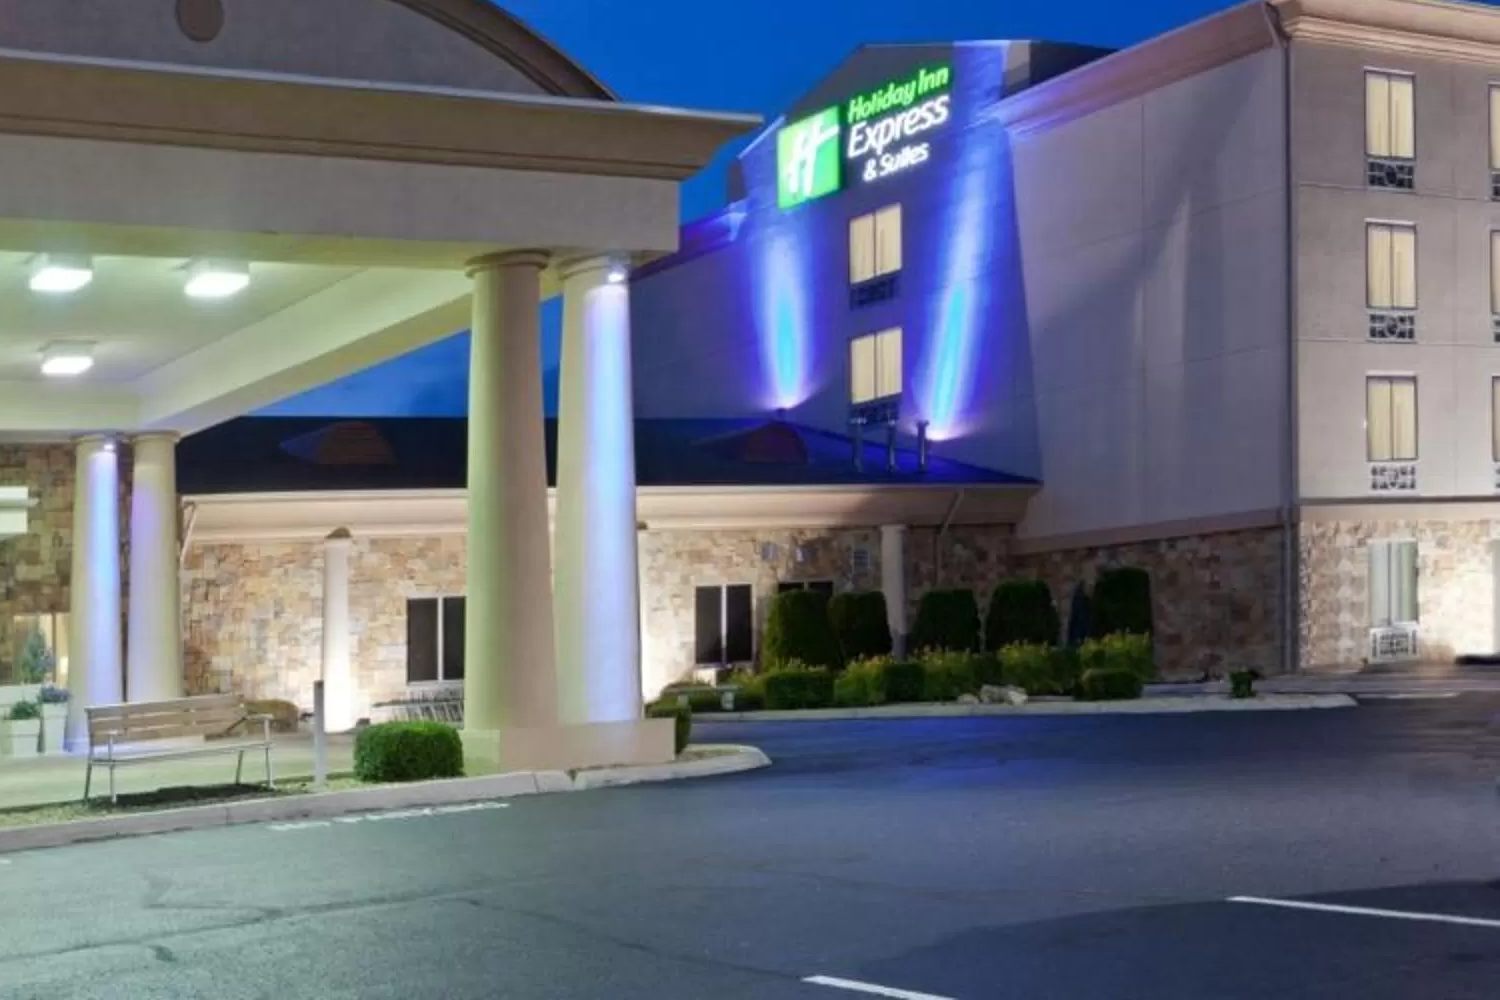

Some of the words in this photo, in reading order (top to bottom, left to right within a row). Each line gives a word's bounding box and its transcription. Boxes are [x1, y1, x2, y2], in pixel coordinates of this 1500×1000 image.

[847, 81, 916, 123] Holiday
[918, 67, 949, 95] Inn
[847, 95, 950, 158] Express
[863, 158, 877, 182] &
[879, 143, 930, 177] Suites
